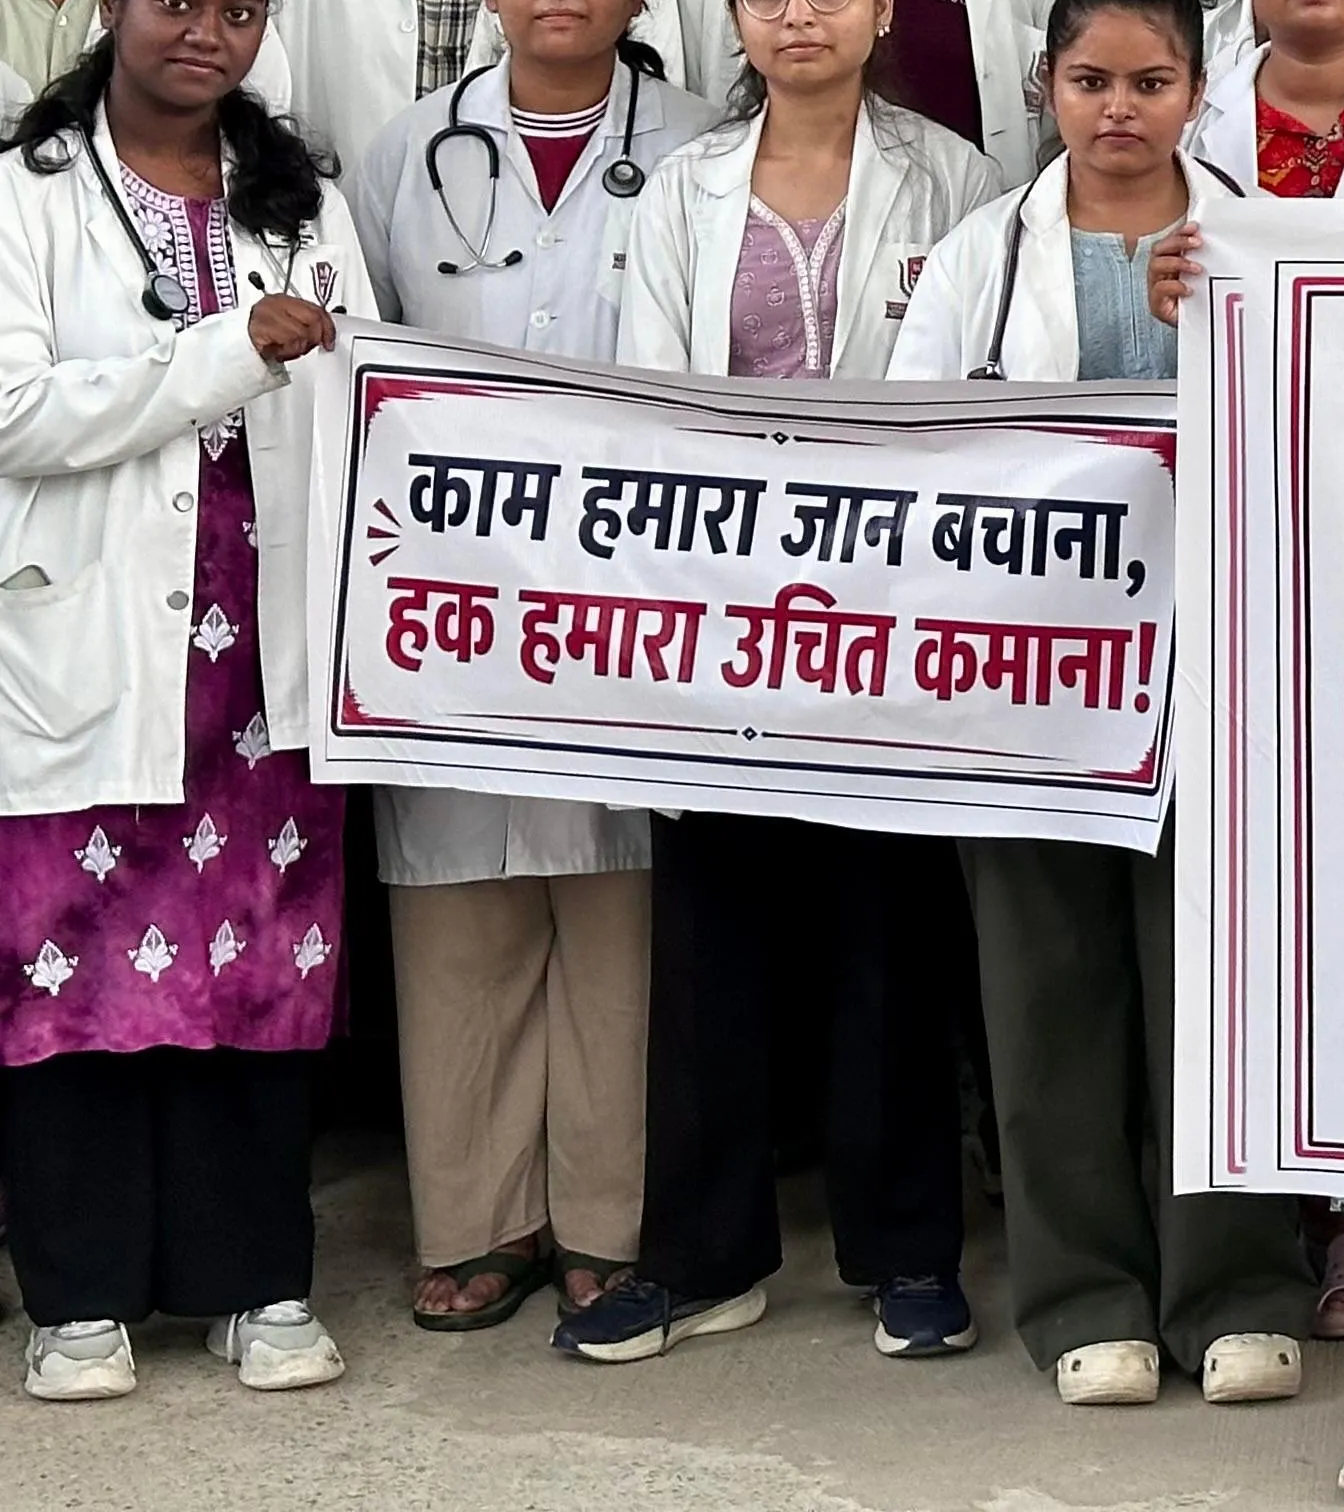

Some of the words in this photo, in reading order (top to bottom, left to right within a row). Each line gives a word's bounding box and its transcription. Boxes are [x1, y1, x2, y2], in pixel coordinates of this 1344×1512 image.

[407, 452, 563, 542] काम
[577, 465, 769, 561] हमारा
[779, 480, 920, 568] जान
[931, 491, 1147, 599] बचाना,
[386, 577, 497, 670] हक
[521, 590, 706, 682] हमारा
[723, 583, 897, 696] उचित
[915, 618, 1155, 710] कमाना!
